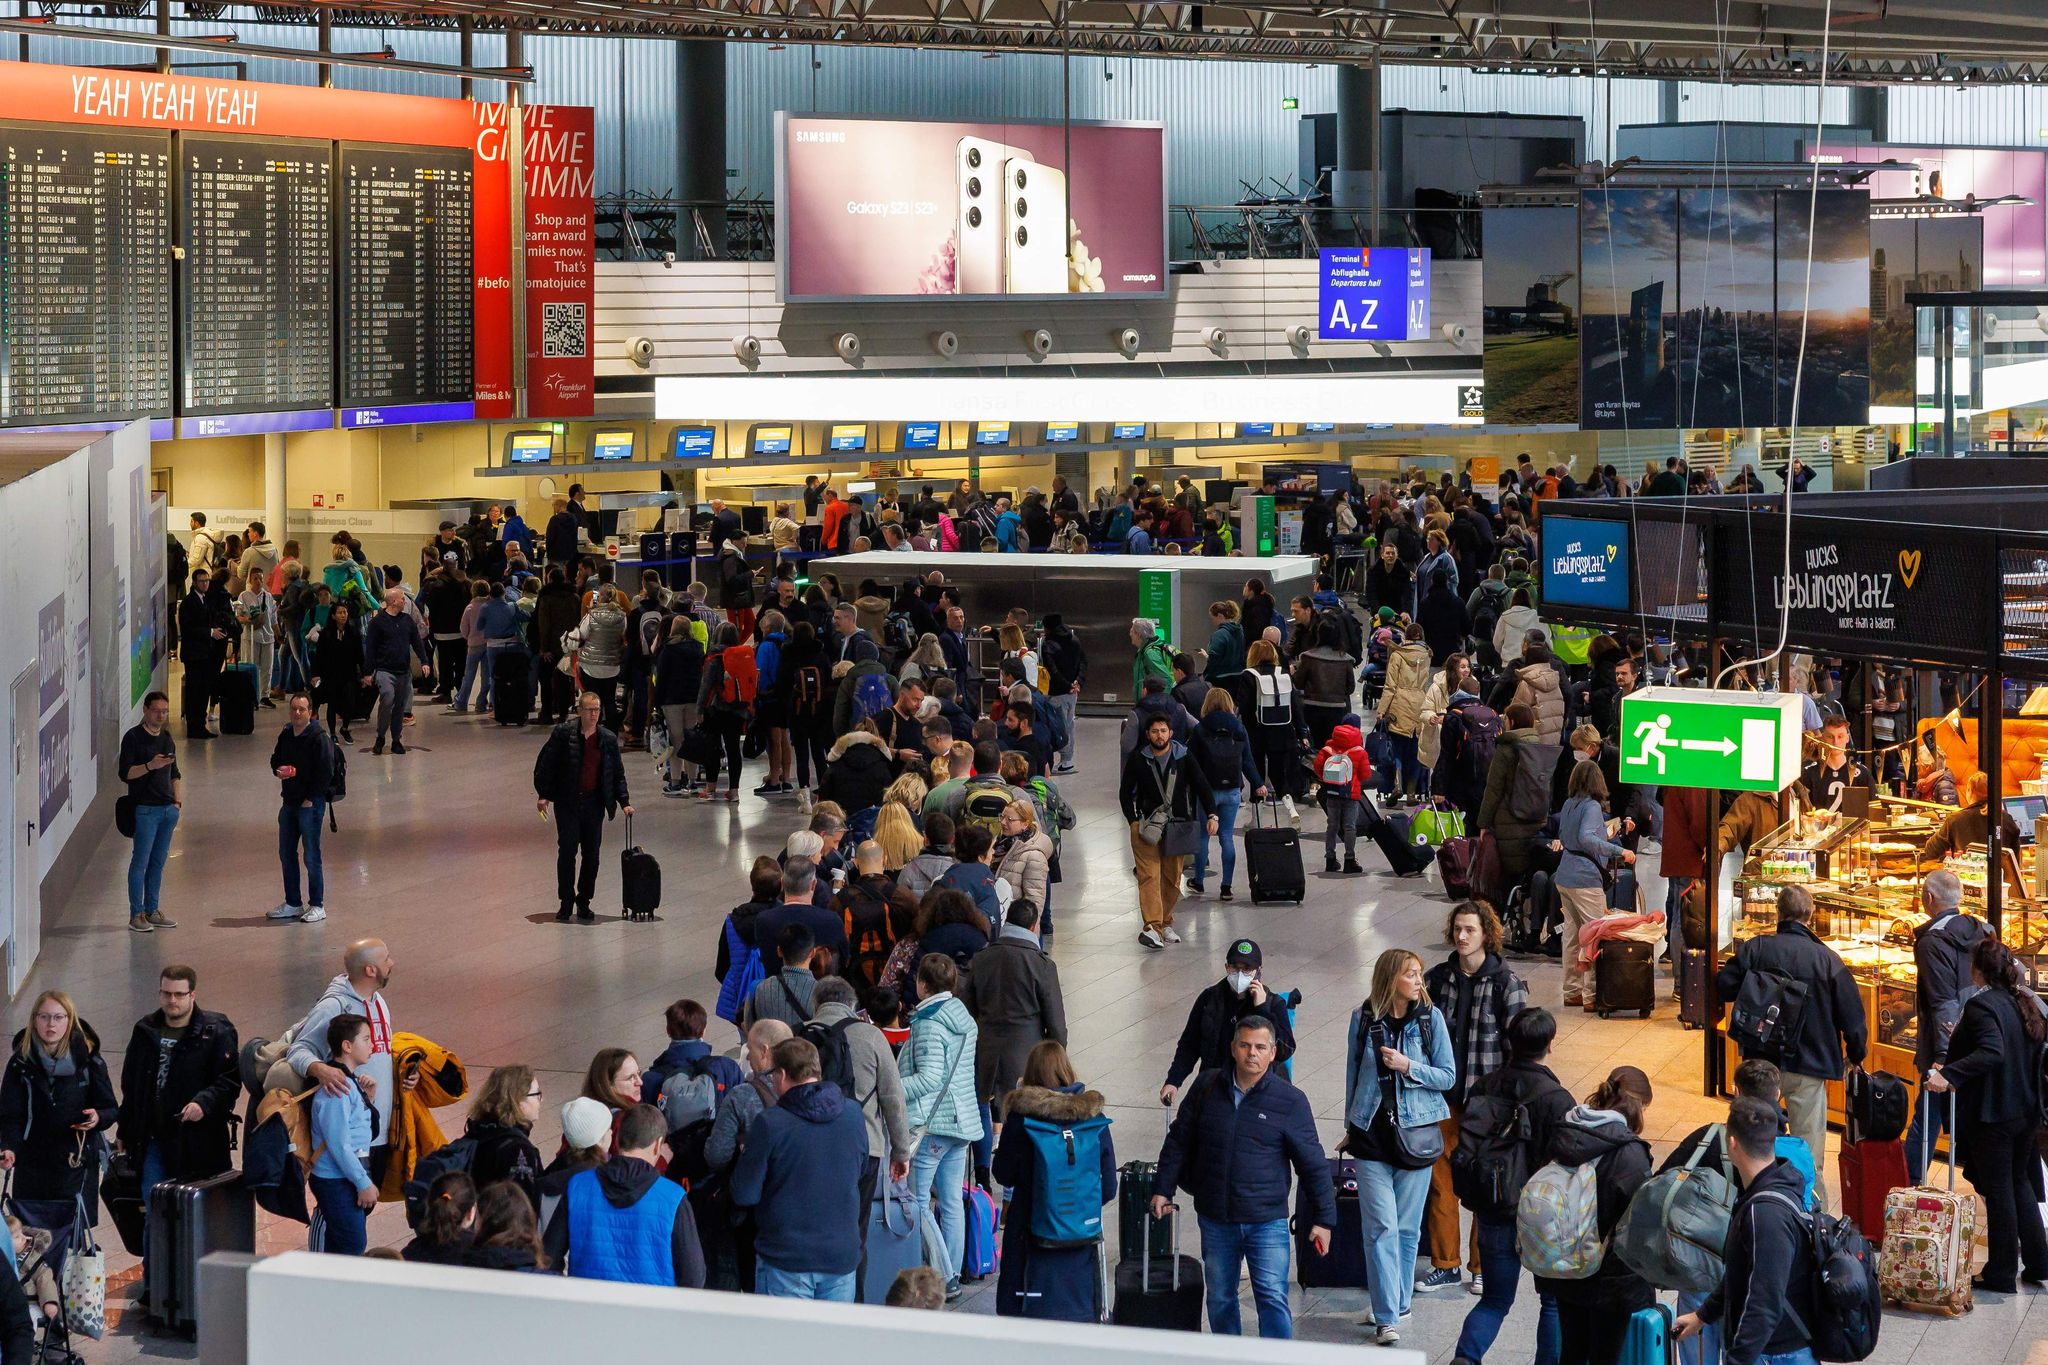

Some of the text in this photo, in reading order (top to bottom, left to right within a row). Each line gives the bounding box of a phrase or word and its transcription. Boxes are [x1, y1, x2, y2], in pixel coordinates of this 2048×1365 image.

[72, 74, 258, 126] YEAH YEAH YEAH
[796, 131, 846, 143] SAMSUNG
[847, 201, 888, 218] Galaxy
[535, 213, 586, 228] Shop and
[526, 230, 586, 240] earn award
[528, 245, 586, 257] miles now.
[1123, 274, 1156, 283] samsung.de
[1331, 269, 1369, 278] Abflughalle
[1331, 279, 1367, 287] Departures
[1329, 299, 1378, 332] A,Z
[476, 391, 496, 400] Miles
[498, 391, 504, 400] &
[558, 391, 579, 400] Airport
[216, 515, 258, 524] Lufthansa
[308, 517, 347, 526] Business
[348, 517, 373, 526] Class
[1805, 544, 1838, 570] HUCKS
